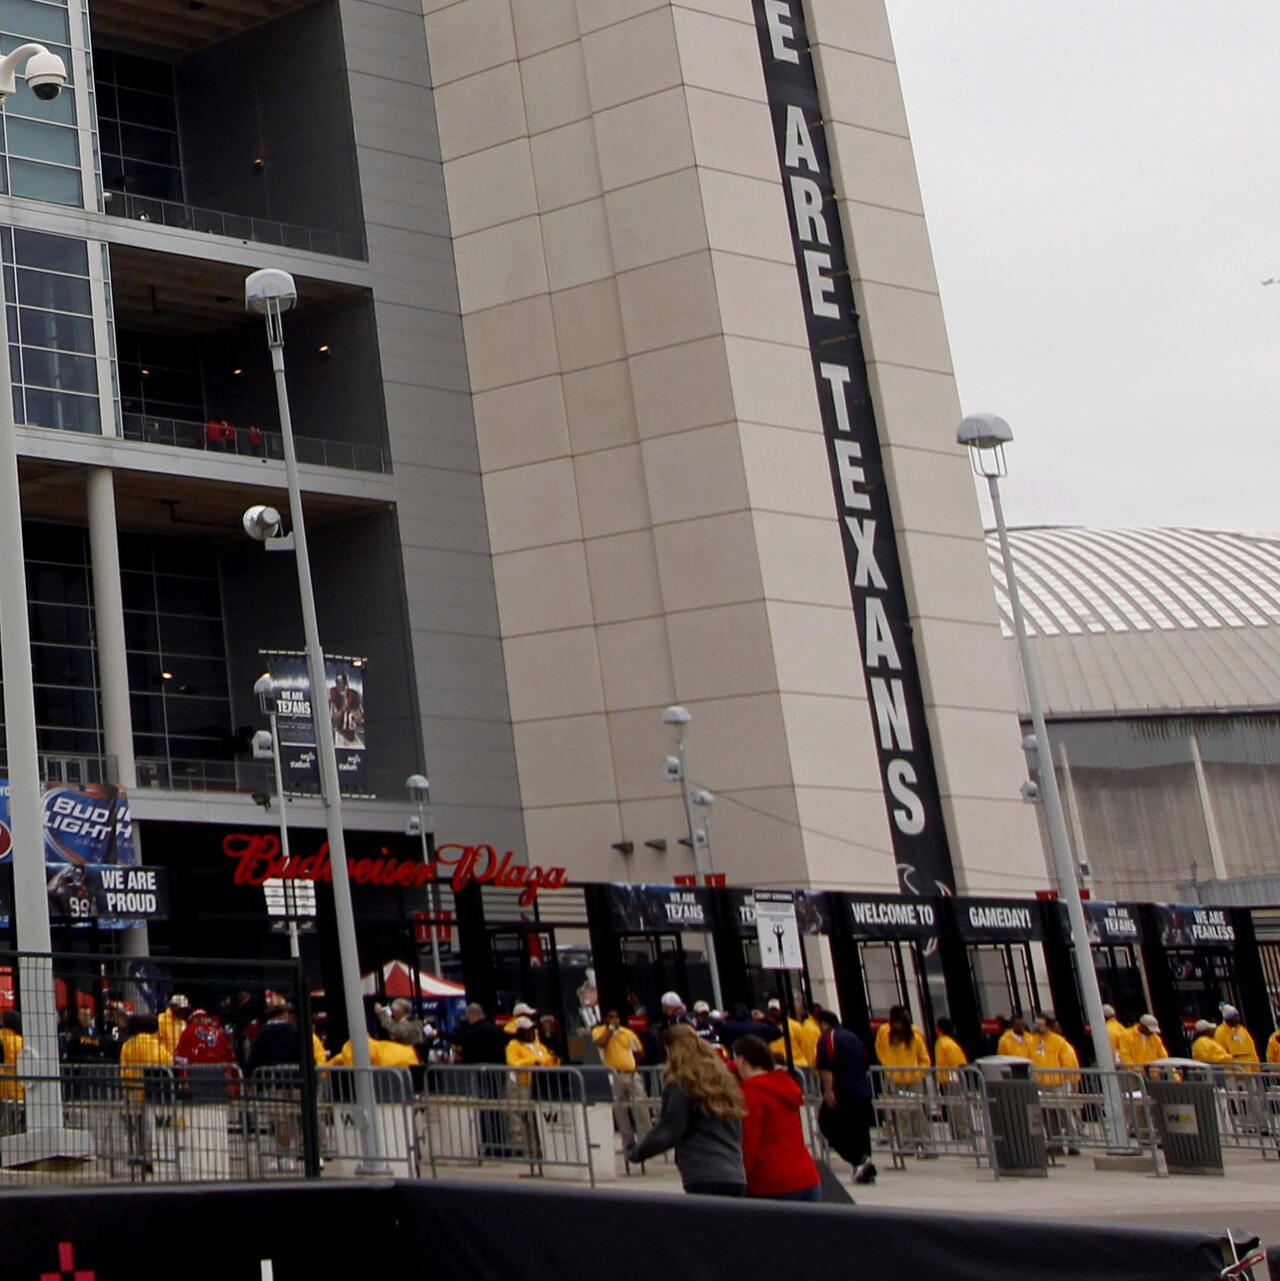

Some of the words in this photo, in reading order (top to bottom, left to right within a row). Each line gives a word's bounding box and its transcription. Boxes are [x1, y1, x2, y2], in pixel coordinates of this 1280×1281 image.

[784, 105, 841, 320] ARE
[820, 361, 925, 836] TEXANS
[277, 700, 311, 715] TEXANS
[53, 796, 110, 823] BUD
[43, 811, 112, 840] LIGHT
[101, 870, 124, 889] WE
[127, 871, 156, 890] ARE
[222, 833, 438, 886] Budeiser
[435, 843, 571, 907] Plaza
[68, 897, 89, 918] 99
[106, 892, 156, 913] PROUD
[665, 903, 704, 919] TEXANS
[1106, 908, 1116, 918] WE
[851, 902, 913, 924] WELCOME
[914, 905, 934, 925] TO
[968, 906, 1032, 929] GAMEDAY!
[1193, 910, 1208, 924] WE
[1208, 911, 1225, 925] ARE
[1104, 917, 1137, 933] TEXANS
[1192, 924, 1235, 941] FEARLESS
